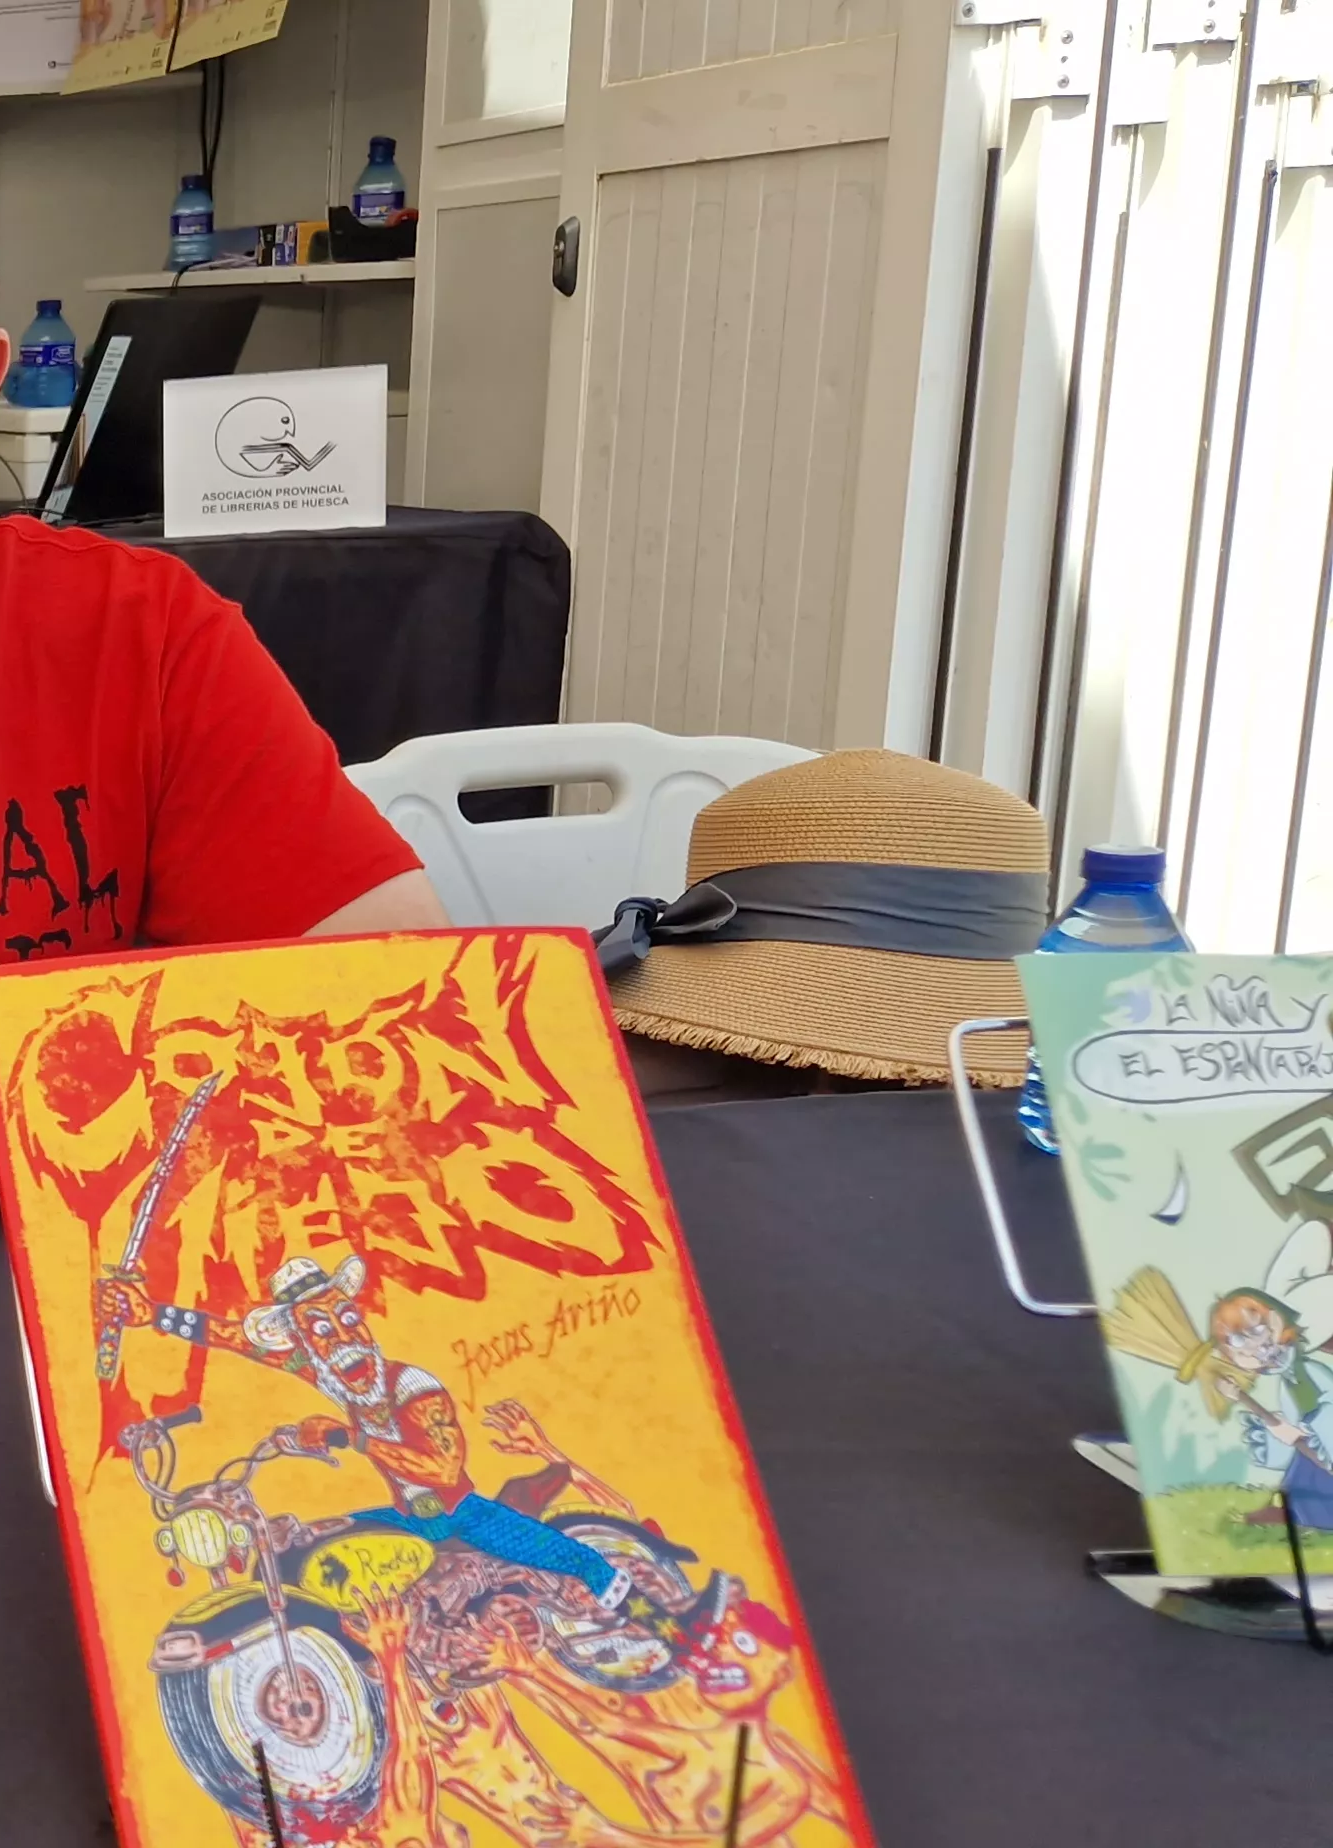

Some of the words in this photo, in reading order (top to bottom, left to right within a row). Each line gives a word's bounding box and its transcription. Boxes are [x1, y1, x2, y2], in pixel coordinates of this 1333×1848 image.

[202, 486, 272, 502] ASOCIACIÓN
[276, 484, 345, 497] PROVINCIAL
[202, 505, 217, 514] DE
[283, 499, 297, 509] DE
[301, 497, 349, 508] HUESCA
[1161, 994, 1198, 1026] LA
[1290, 993, 1329, 1032] Y
[1118, 1049, 1165, 1077] EL
[251, 1118, 387, 1160] DE
[451, 1324, 535, 1414] Josas
[537, 1282, 641, 1359] Ariño
